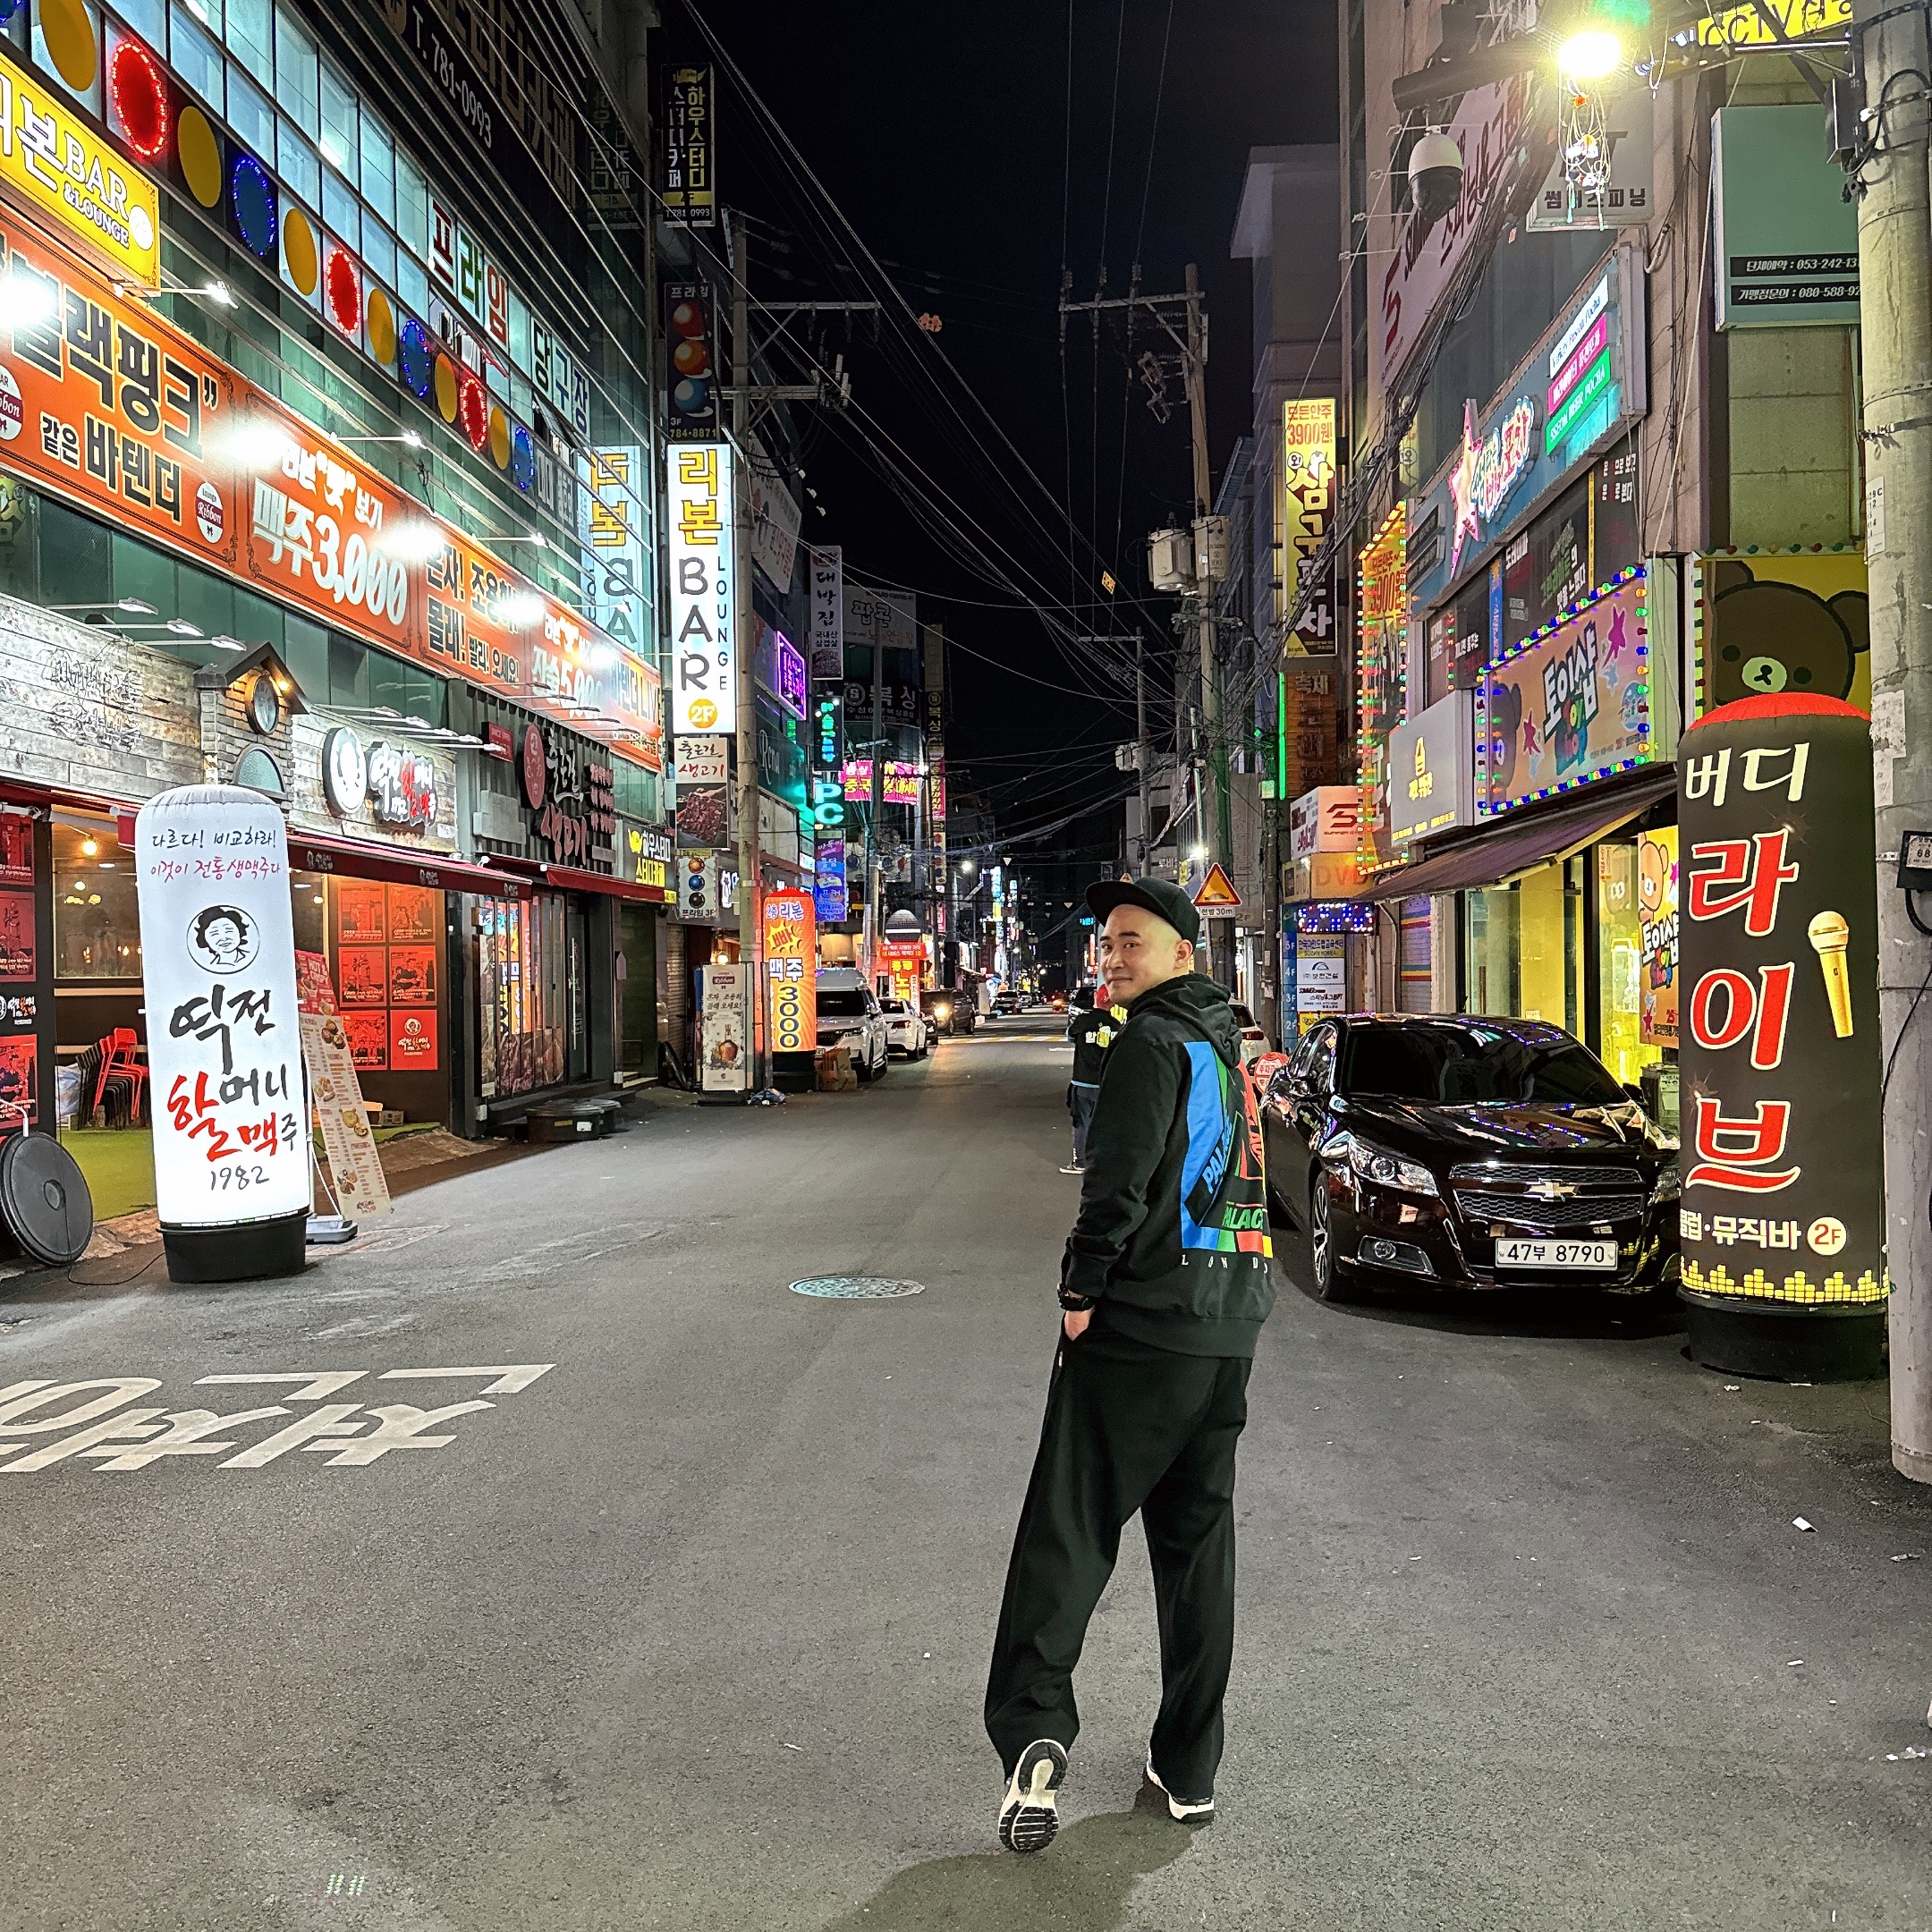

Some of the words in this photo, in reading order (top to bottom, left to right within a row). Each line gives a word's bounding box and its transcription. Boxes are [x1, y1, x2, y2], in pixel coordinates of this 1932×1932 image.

[688, 87, 706, 187] 하우스터디
[64, 131, 130, 222] BAR
[432, 198, 509, 348] 프라임
[1796, 258, 1860, 271] 053-242-13
[670, 286, 708, 299] 프라임
[535, 322, 588, 436] 당구장
[670, 418, 682, 426] 3F
[41, 412, 80, 470] 같은
[85, 411, 182, 526] 바텐더
[678, 447, 723, 546] 리본
[197, 501, 222, 526] Ribbon
[253, 477, 315, 578] 맥주
[312, 514, 408, 625] 3,000
[815, 570, 837, 627] 대박집
[428, 594, 465, 662] 몰래!
[678, 555, 714, 691] BAR
[716, 555, 728, 691] LOUNGE
[815, 631, 838, 639] 국내산
[690, 704, 716, 724] 2F
[678, 763, 724, 778] 생고기
[1685, 741, 1810, 807] 버디
[815, 783, 844, 825] PC
[152, 828, 204, 849] 다르다!
[213, 825, 277, 849] 비교하라!
[150, 860, 189, 883] 이것이
[1315, 864, 1368, 886] DVD
[682, 909, 704, 918] 프라임
[1201, 907, 1215, 917] 전방
[1216, 907, 1233, 917] 30m
[1285, 966, 1296, 977] 4F
[169, 984, 275, 1076] 역전
[779, 986, 800, 1049] 3000
[1285, 1020, 1297, 1030] 2F
[211, 1165, 270, 1191] 1982
[1814, 1224, 1843, 1246] 2F
[1507, 1243, 1546, 1261] 47부
[1555, 1244, 1606, 1263] 8790
